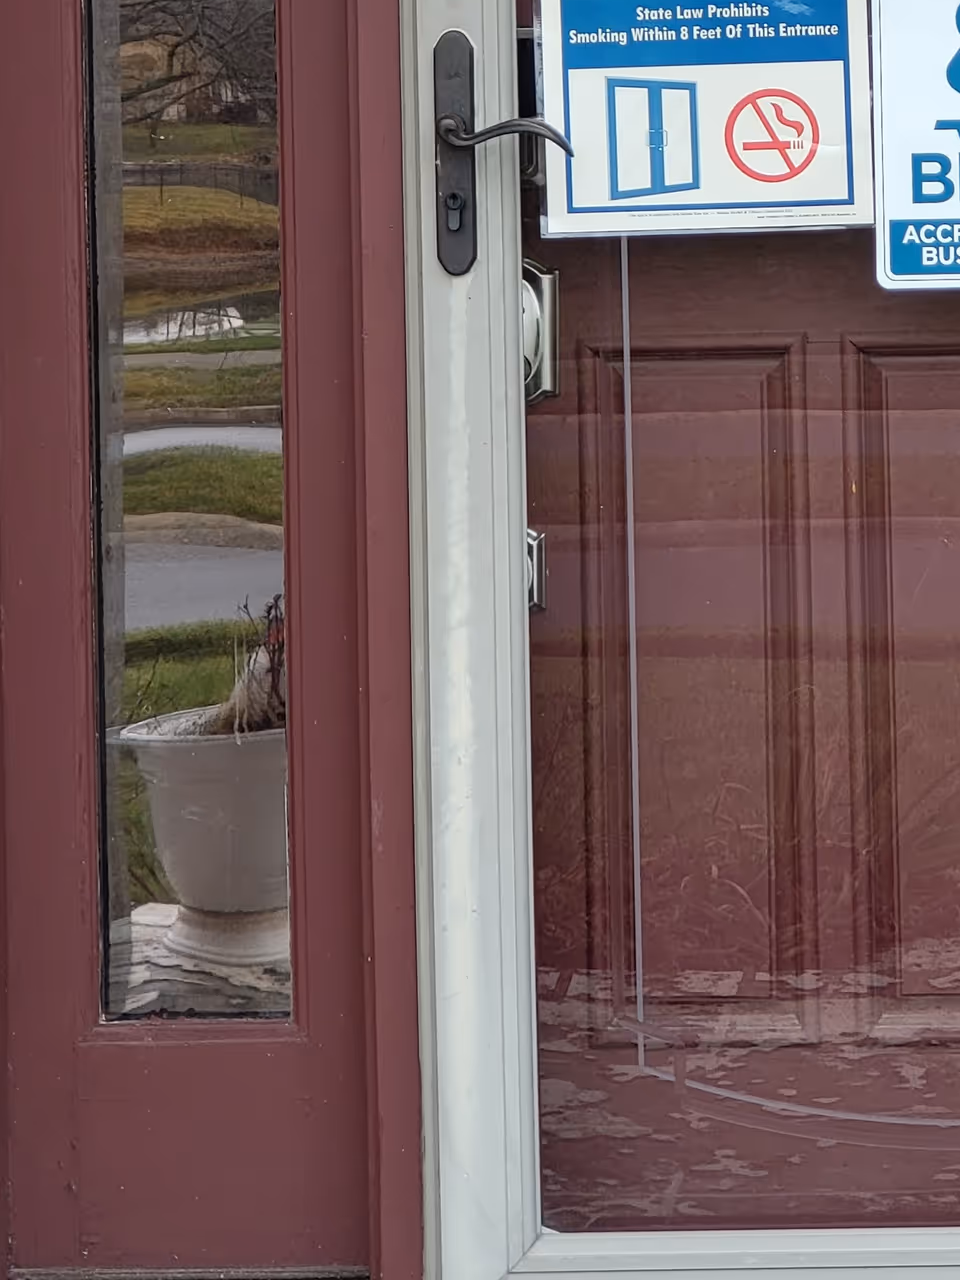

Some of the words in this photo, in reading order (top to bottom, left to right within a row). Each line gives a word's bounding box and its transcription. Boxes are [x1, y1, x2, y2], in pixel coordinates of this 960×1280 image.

[635, 5, 673, 21] State
[676, 5, 705, 20] Law
[707, 3, 770, 19] Prohibits
[568, 27, 628, 46] Smoking
[632, 26, 677, 42] Within
[680, 27, 689, 41] 8
[692, 25, 722, 40] Feet
[726, 23, 743, 39] Of
[747, 23, 775, 38] This
[778, 21, 839, 37] Entrance
